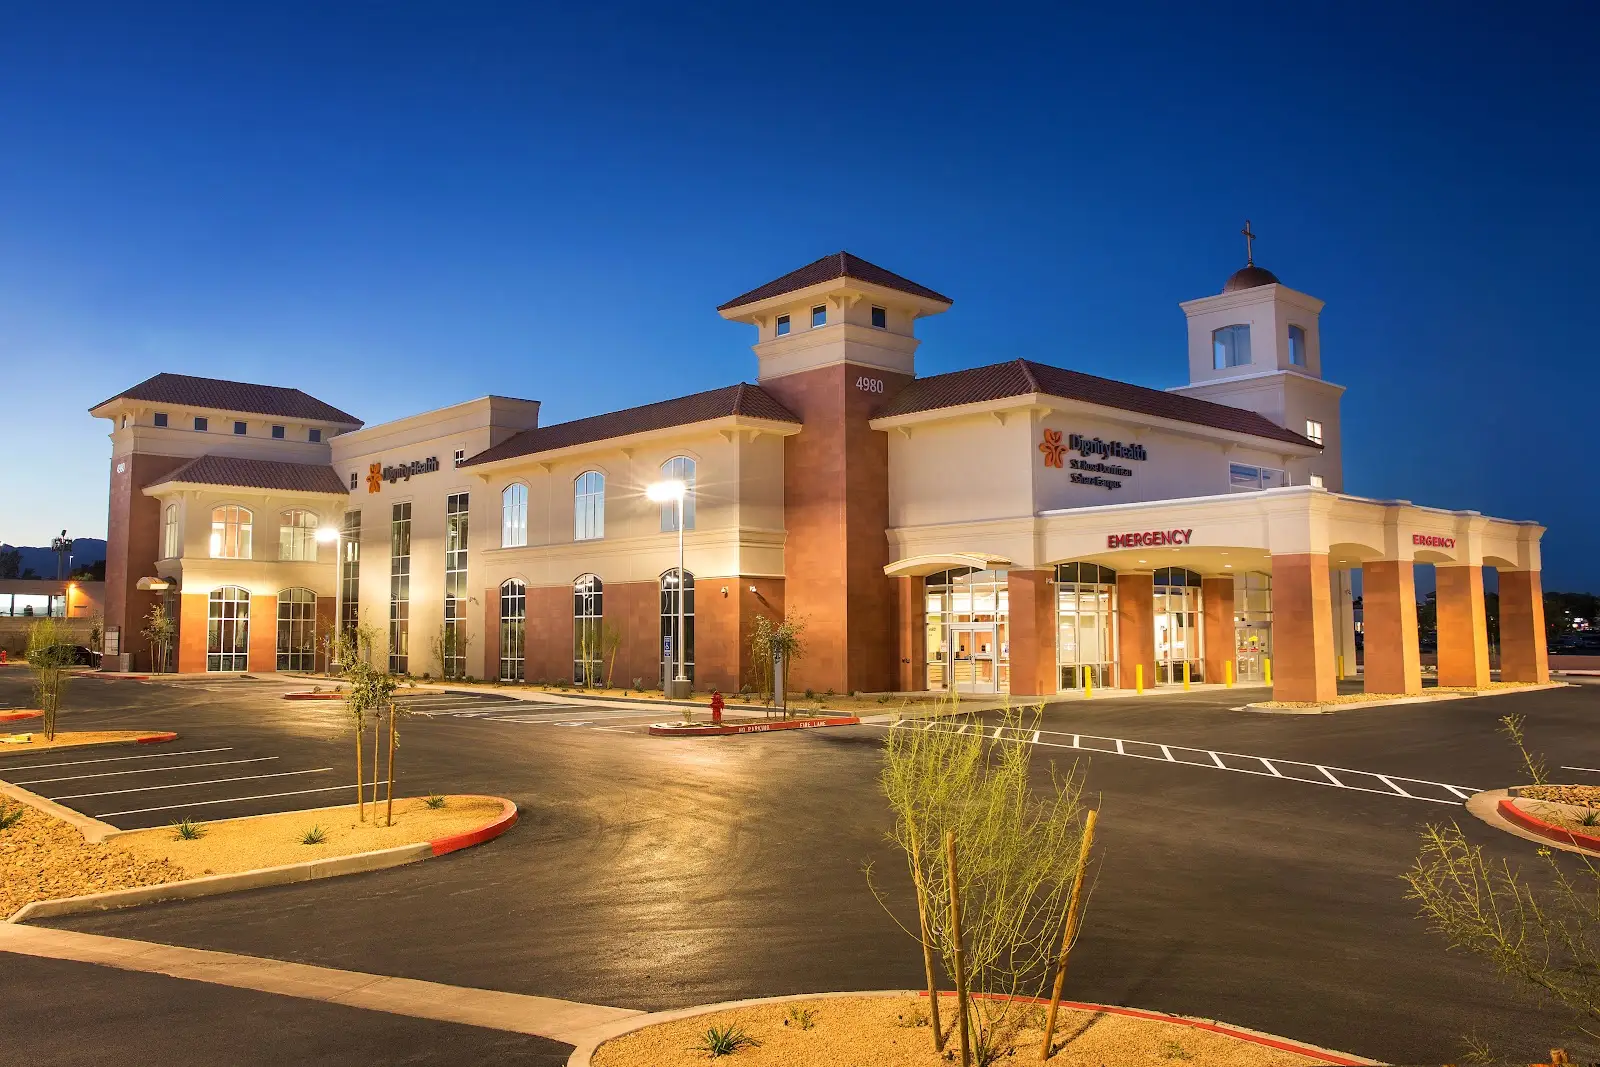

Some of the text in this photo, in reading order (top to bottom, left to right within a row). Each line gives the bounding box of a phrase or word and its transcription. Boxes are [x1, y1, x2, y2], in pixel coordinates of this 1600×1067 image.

[856, 376, 884, 394] 4980
[1069, 434, 1147, 461] Dignity Health
[411, 457, 439, 475] Health
[1108, 529, 1192, 548] EMERGENCY
[1412, 534, 1456, 548] ERGENCY
